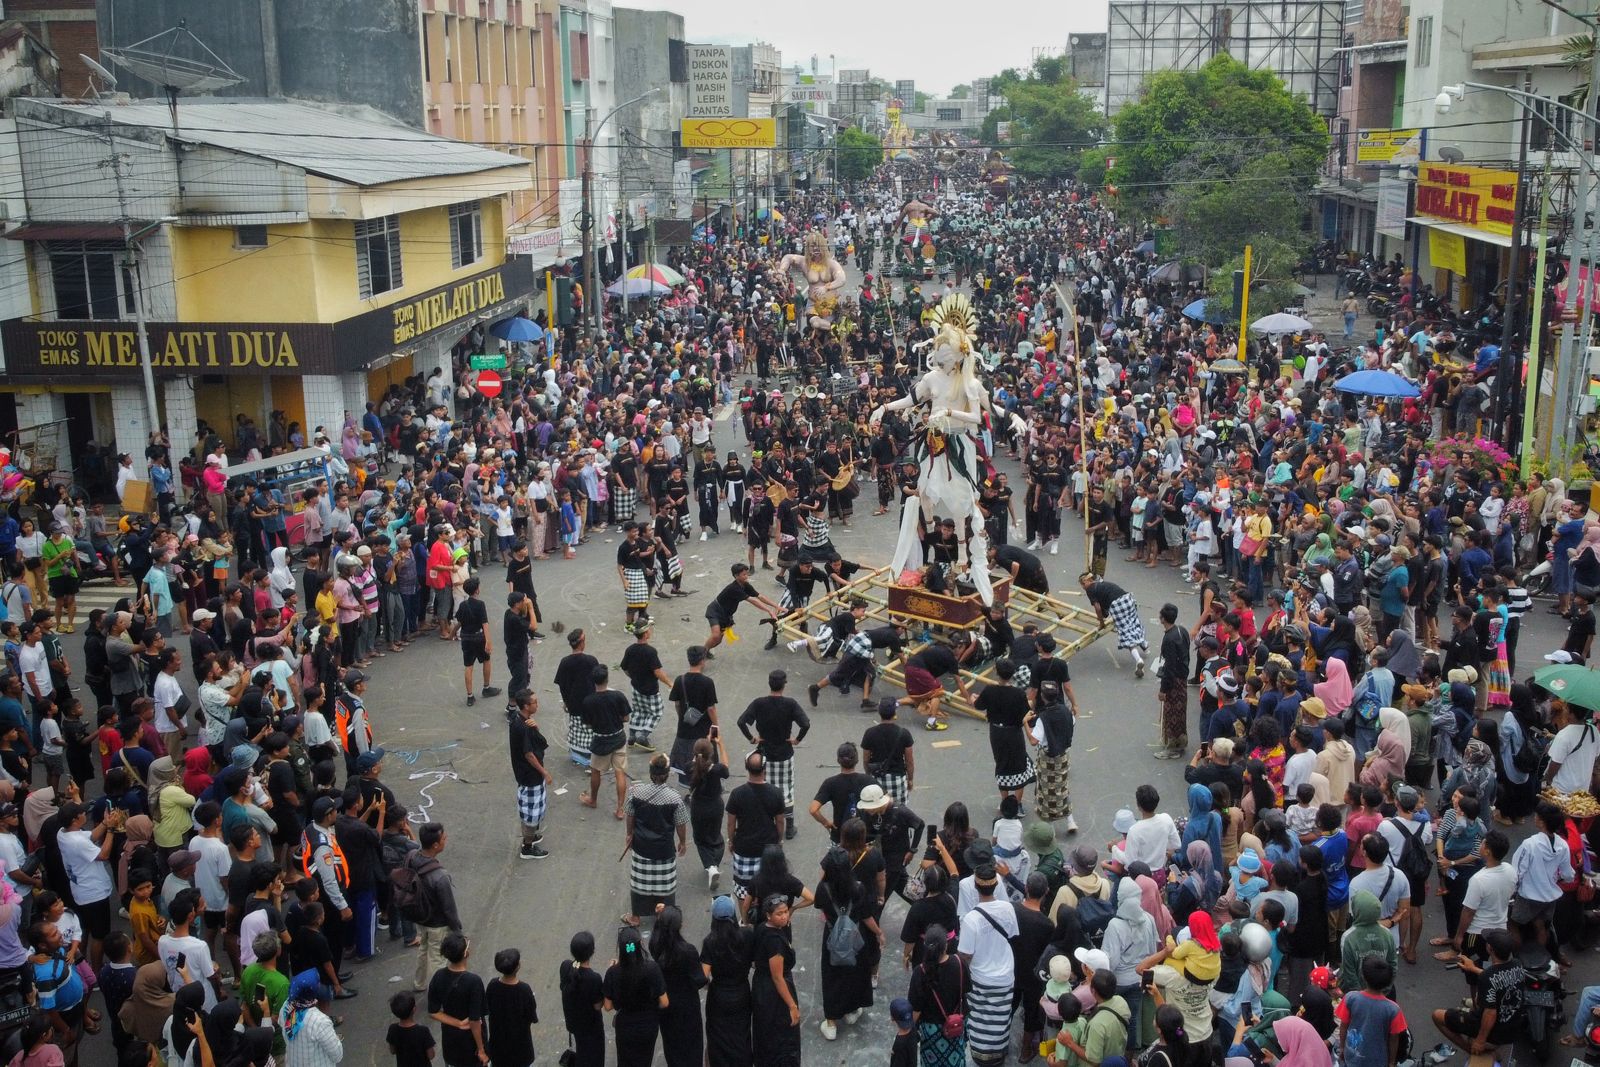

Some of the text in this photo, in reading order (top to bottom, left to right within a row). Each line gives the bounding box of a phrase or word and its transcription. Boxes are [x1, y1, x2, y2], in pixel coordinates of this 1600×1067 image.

[694, 48, 725, 58] TANPA
[691, 60, 728, 70] DISKON
[693, 71, 727, 81] HARGA
[695, 83, 725, 92] MASIH
[697, 94, 725, 104] LEBIH
[791, 90, 832, 100] SARI BUSANA
[692, 105, 730, 115] PANTAS
[689, 137, 768, 146] SINAR MAS OPTIK
[534, 231, 561, 249] CHANGER
[415, 272, 505, 335] MELATI DUA
[393, 305, 414, 324] TOKO
[37, 330, 78, 346] TOKO
[394, 323, 414, 344] EMAS
[227, 331, 299, 367] DUA
[40, 349, 80, 365] EMAS
